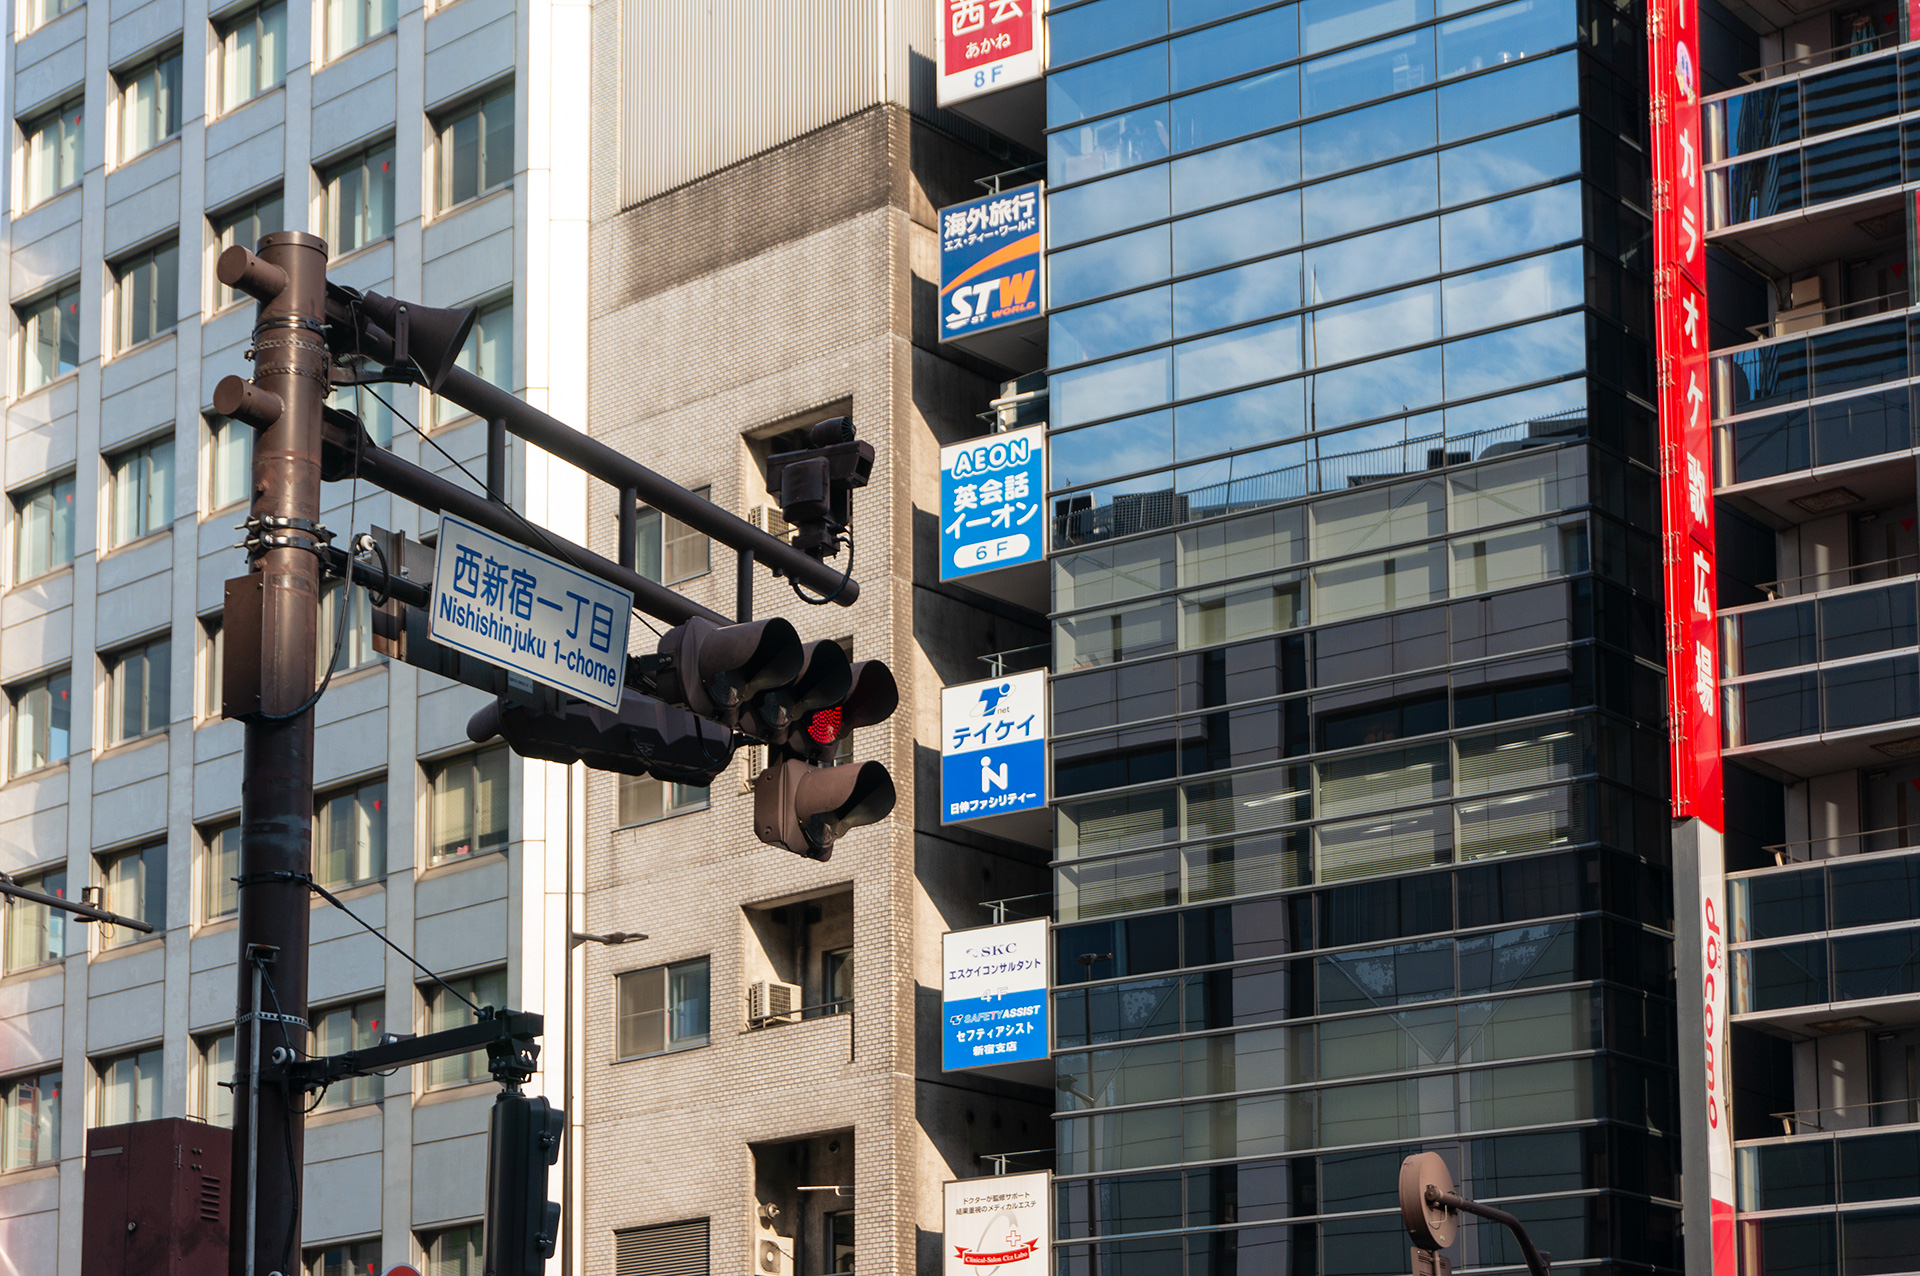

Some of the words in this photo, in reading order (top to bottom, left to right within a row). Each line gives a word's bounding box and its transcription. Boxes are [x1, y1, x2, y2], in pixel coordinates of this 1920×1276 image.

[965, 32, 1012, 59] あかね
[944, 191, 1035, 240] 海外旅行
[991, 301, 1036, 319] WORLD
[1679, 127, 1713, 717] カラオケ歌広場
[955, 440, 1029, 477] AEON
[953, 471, 1030, 513] 英会話
[945, 503, 1039, 540] イーオン
[453, 543, 614, 654] 西新宿一丁目
[439, 592, 547, 660] Nishishinjuku
[553, 639, 617, 688] 1-chome
[952, 714, 1036, 749] テイケイ
[981, 942, 1018, 958] SKC
[949, 958, 1041, 981] エスケイコンサルタント
[956, 1021, 1034, 1043] セフティアシスト
[1704, 897, 1720, 1130] docomo
[972, 1041, 1018, 1056] 新宿支店
